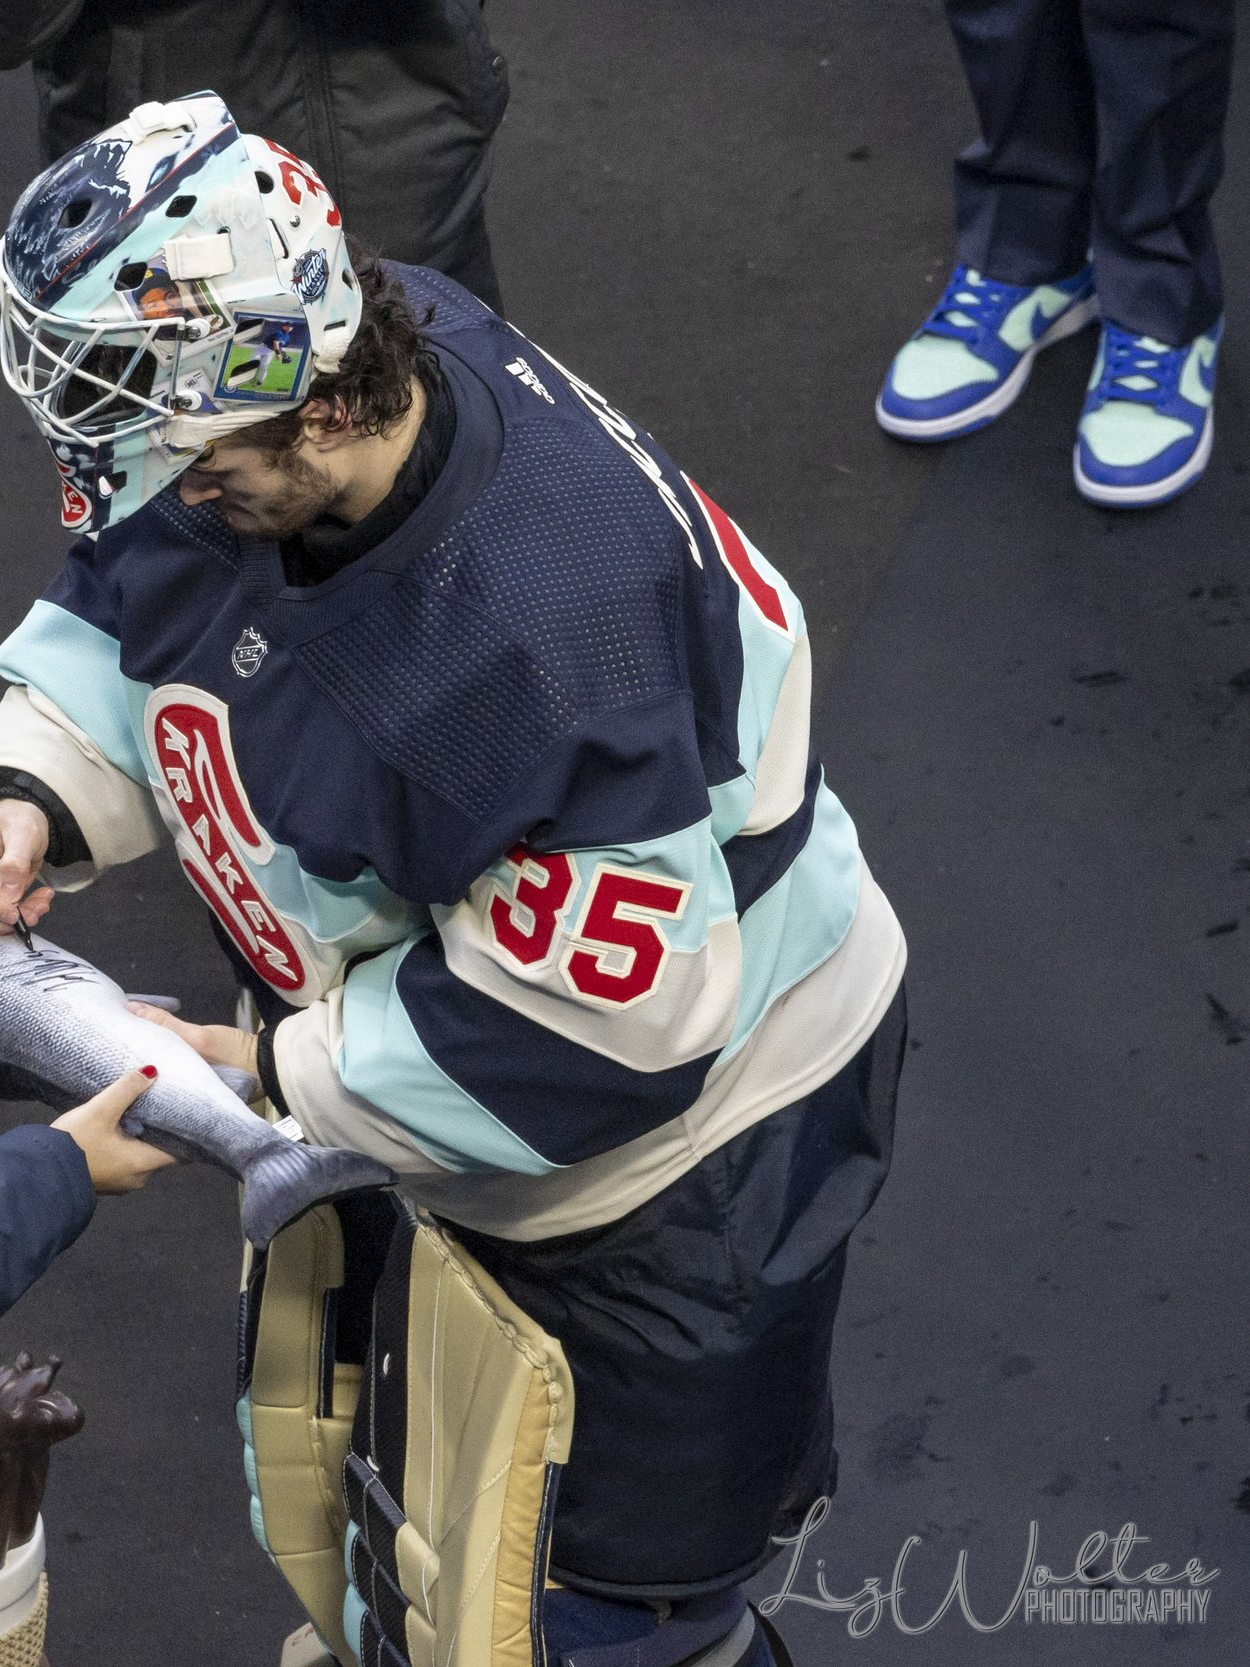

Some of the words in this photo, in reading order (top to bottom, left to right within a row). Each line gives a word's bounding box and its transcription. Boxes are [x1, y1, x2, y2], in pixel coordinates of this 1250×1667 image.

[291, 248, 327, 305] Winter
[236, 648, 259, 660] NHL
[161, 717, 298, 982] KRAKEN
[489, 840, 694, 1011] 35
